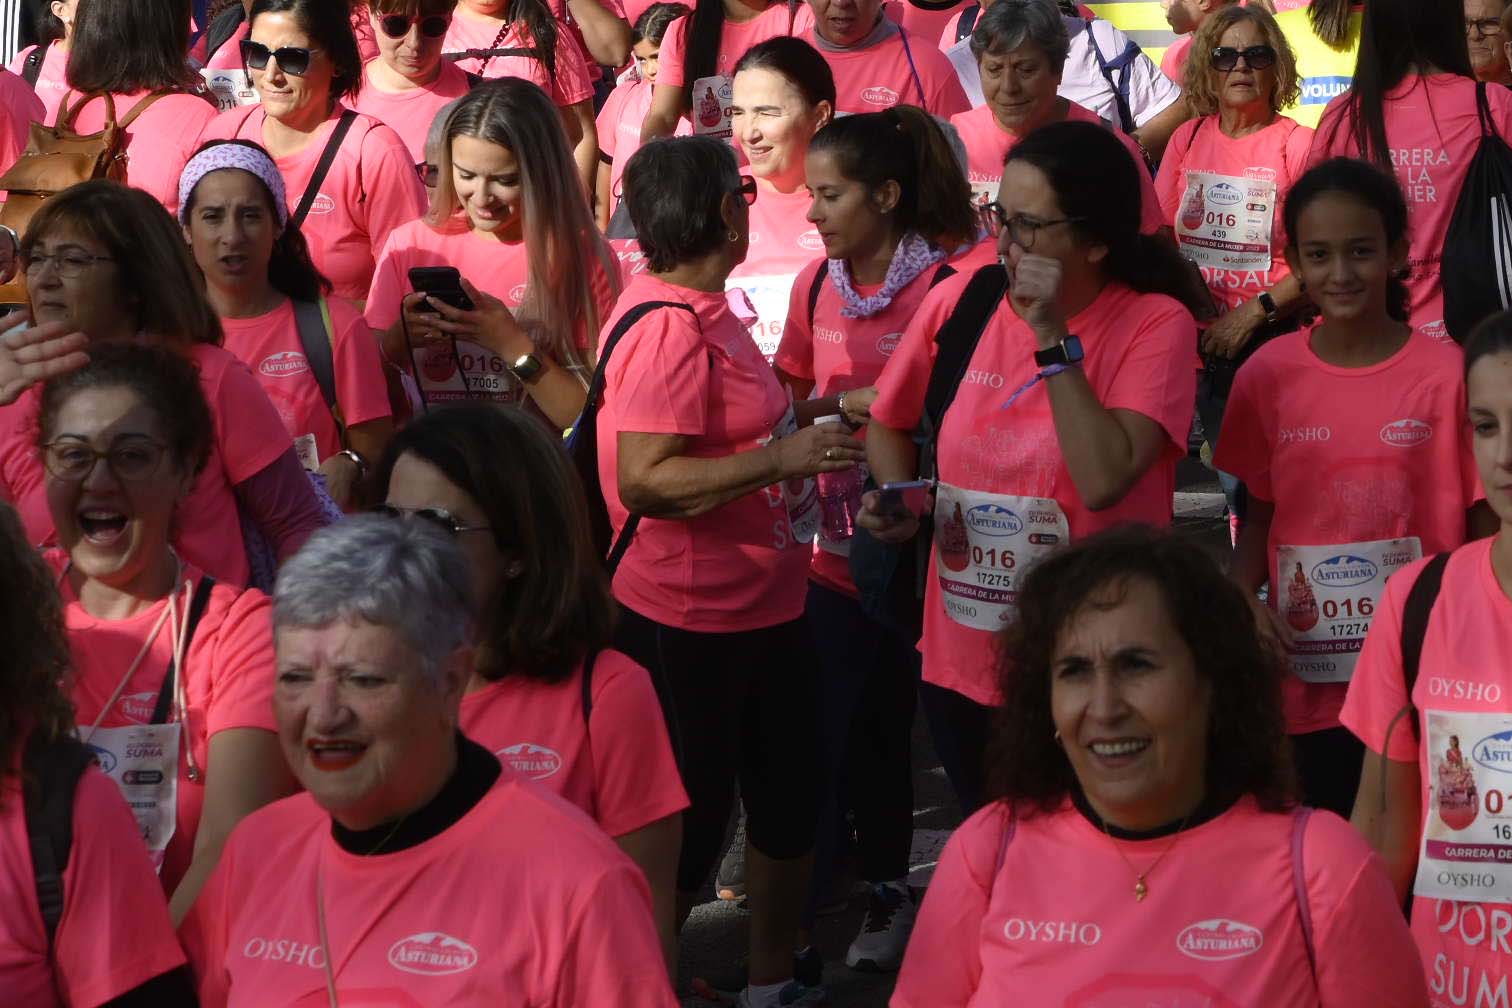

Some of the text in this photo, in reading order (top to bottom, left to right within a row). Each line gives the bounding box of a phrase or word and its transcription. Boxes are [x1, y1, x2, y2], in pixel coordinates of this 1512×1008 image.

[1302, 83, 1349, 98] VOLUN
[1407, 167, 1433, 184] LA
[1206, 212, 1236, 227] 016
[1211, 230, 1227, 239] 439
[750, 320, 782, 338] 16
[461, 355, 503, 372] 016
[1278, 426, 1331, 442] OYSHO
[971, 513, 1018, 531] ASTURIANA
[1028, 516, 1058, 525] SUMA
[972, 546, 1016, 569] 016
[976, 572, 1010, 588] 17275
[1316, 567, 1373, 581] ASTURIANA
[947, 583, 977, 597] CARRERA
[978, 590, 987, 599] DE
[989, 592, 999, 600] LA
[1322, 597, 1374, 619] 016
[1330, 623, 1369, 637] 17274
[1349, 642, 1360, 650] LA
[1428, 677, 1501, 703] OYSHO
[126, 748, 163, 759] SUMA
[1445, 846, 1496, 859] CARRERA
[1498, 848, 1512, 859] DE
[1437, 871, 1496, 889] OYSHO
[1003, 918, 1102, 945] OYSHO
[1184, 932, 1256, 955] ASTURIANA
[244, 936, 328, 970] OYSHO
[393, 944, 471, 969] ASTURIANA
